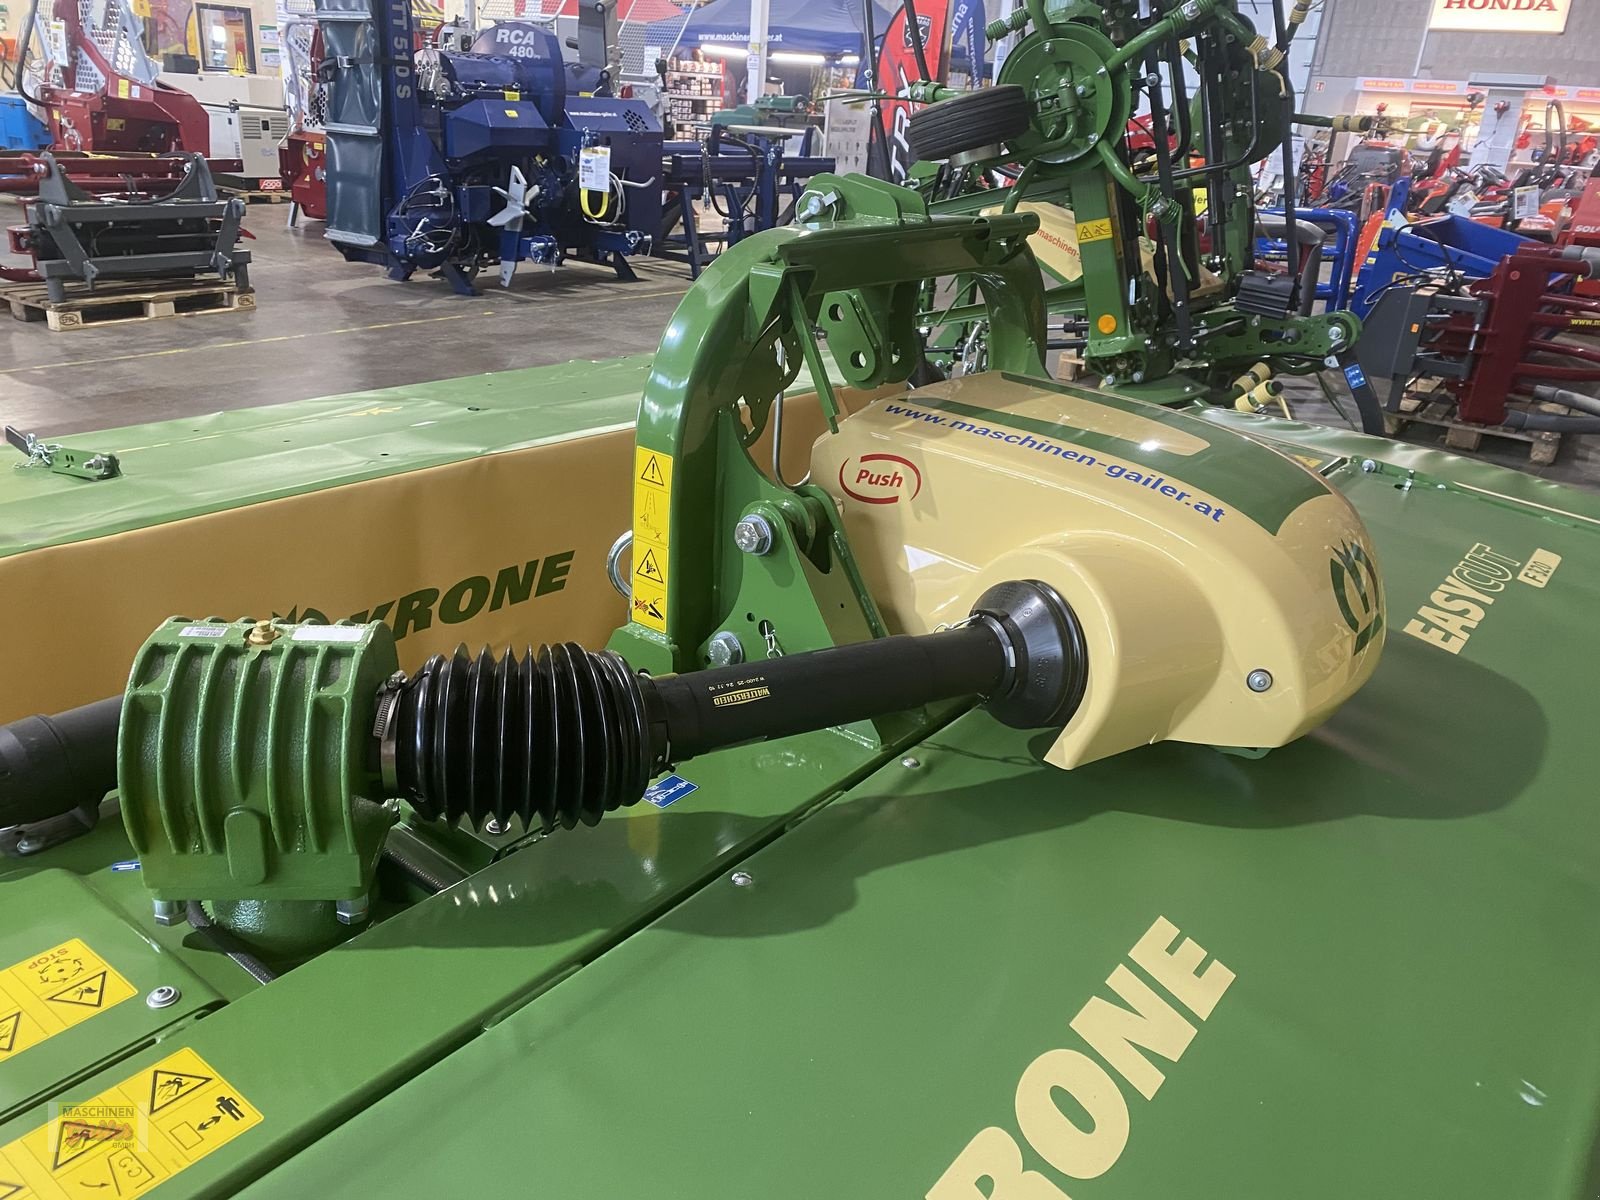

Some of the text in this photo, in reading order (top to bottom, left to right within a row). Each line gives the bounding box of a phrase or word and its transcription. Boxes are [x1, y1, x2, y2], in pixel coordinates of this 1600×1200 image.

[1442, 0, 1559, 11] HONDA
[496, 28, 535, 46] RCA
[393, 36, 410, 78] 510
[509, 45, 535, 59] 480
[396, 84, 411, 99] S
[885, 404, 1226, 523] www.maschinen-gailer.at
[856, 469, 903, 488] Push
[713, 687, 770, 706] WALTERSCHEID
[28, 948, 69, 970] STOP
